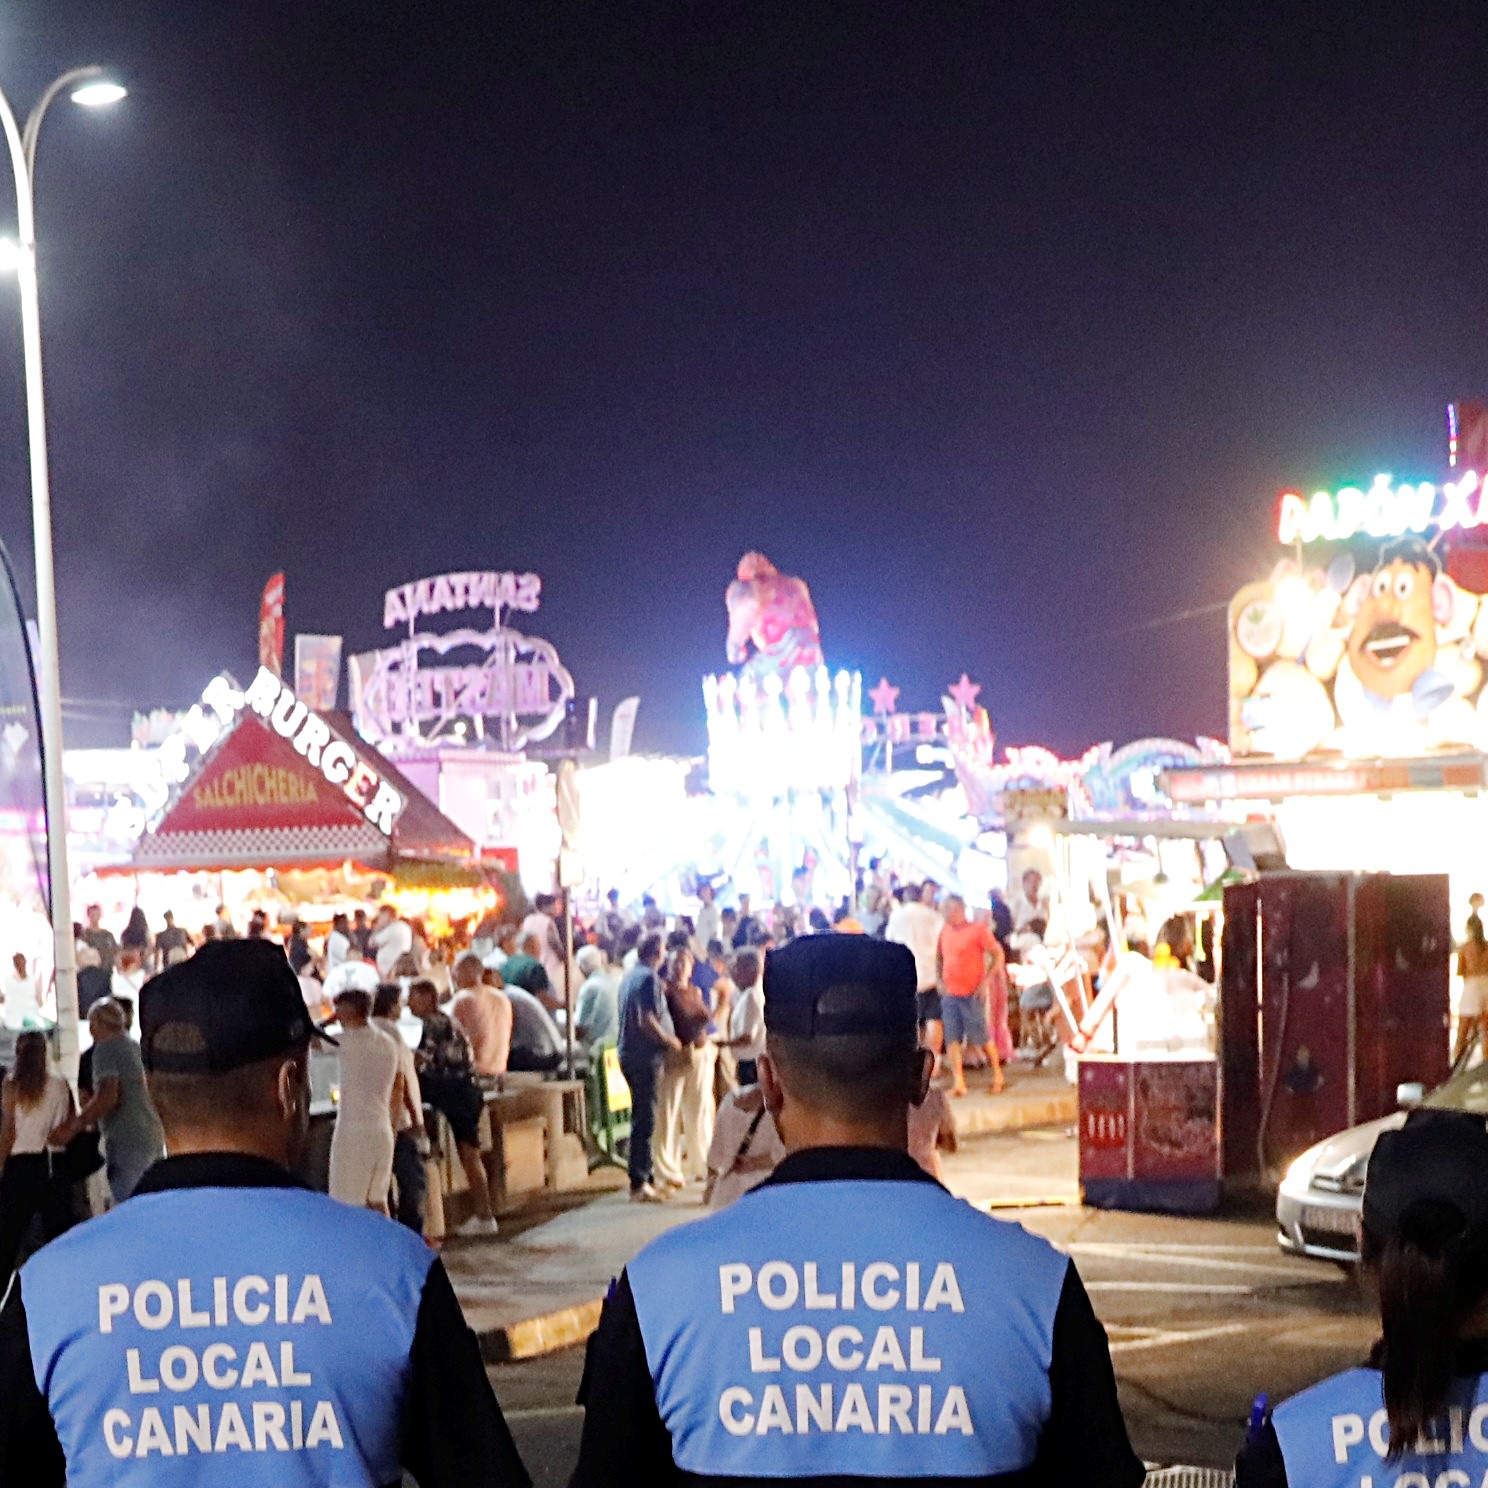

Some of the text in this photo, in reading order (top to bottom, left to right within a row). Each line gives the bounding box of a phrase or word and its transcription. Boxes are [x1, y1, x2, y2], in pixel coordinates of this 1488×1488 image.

[244, 665, 402, 835] BURGER
[98, 1274, 333, 1334] POLICIA
[719, 1260, 966, 1314] POLICIA
[126, 1341, 312, 1394] LOCAL
[748, 1324, 942, 1373] LOCAL
[103, 1401, 344, 1459] CANARIA
[718, 1383, 975, 1436] CANARIA
